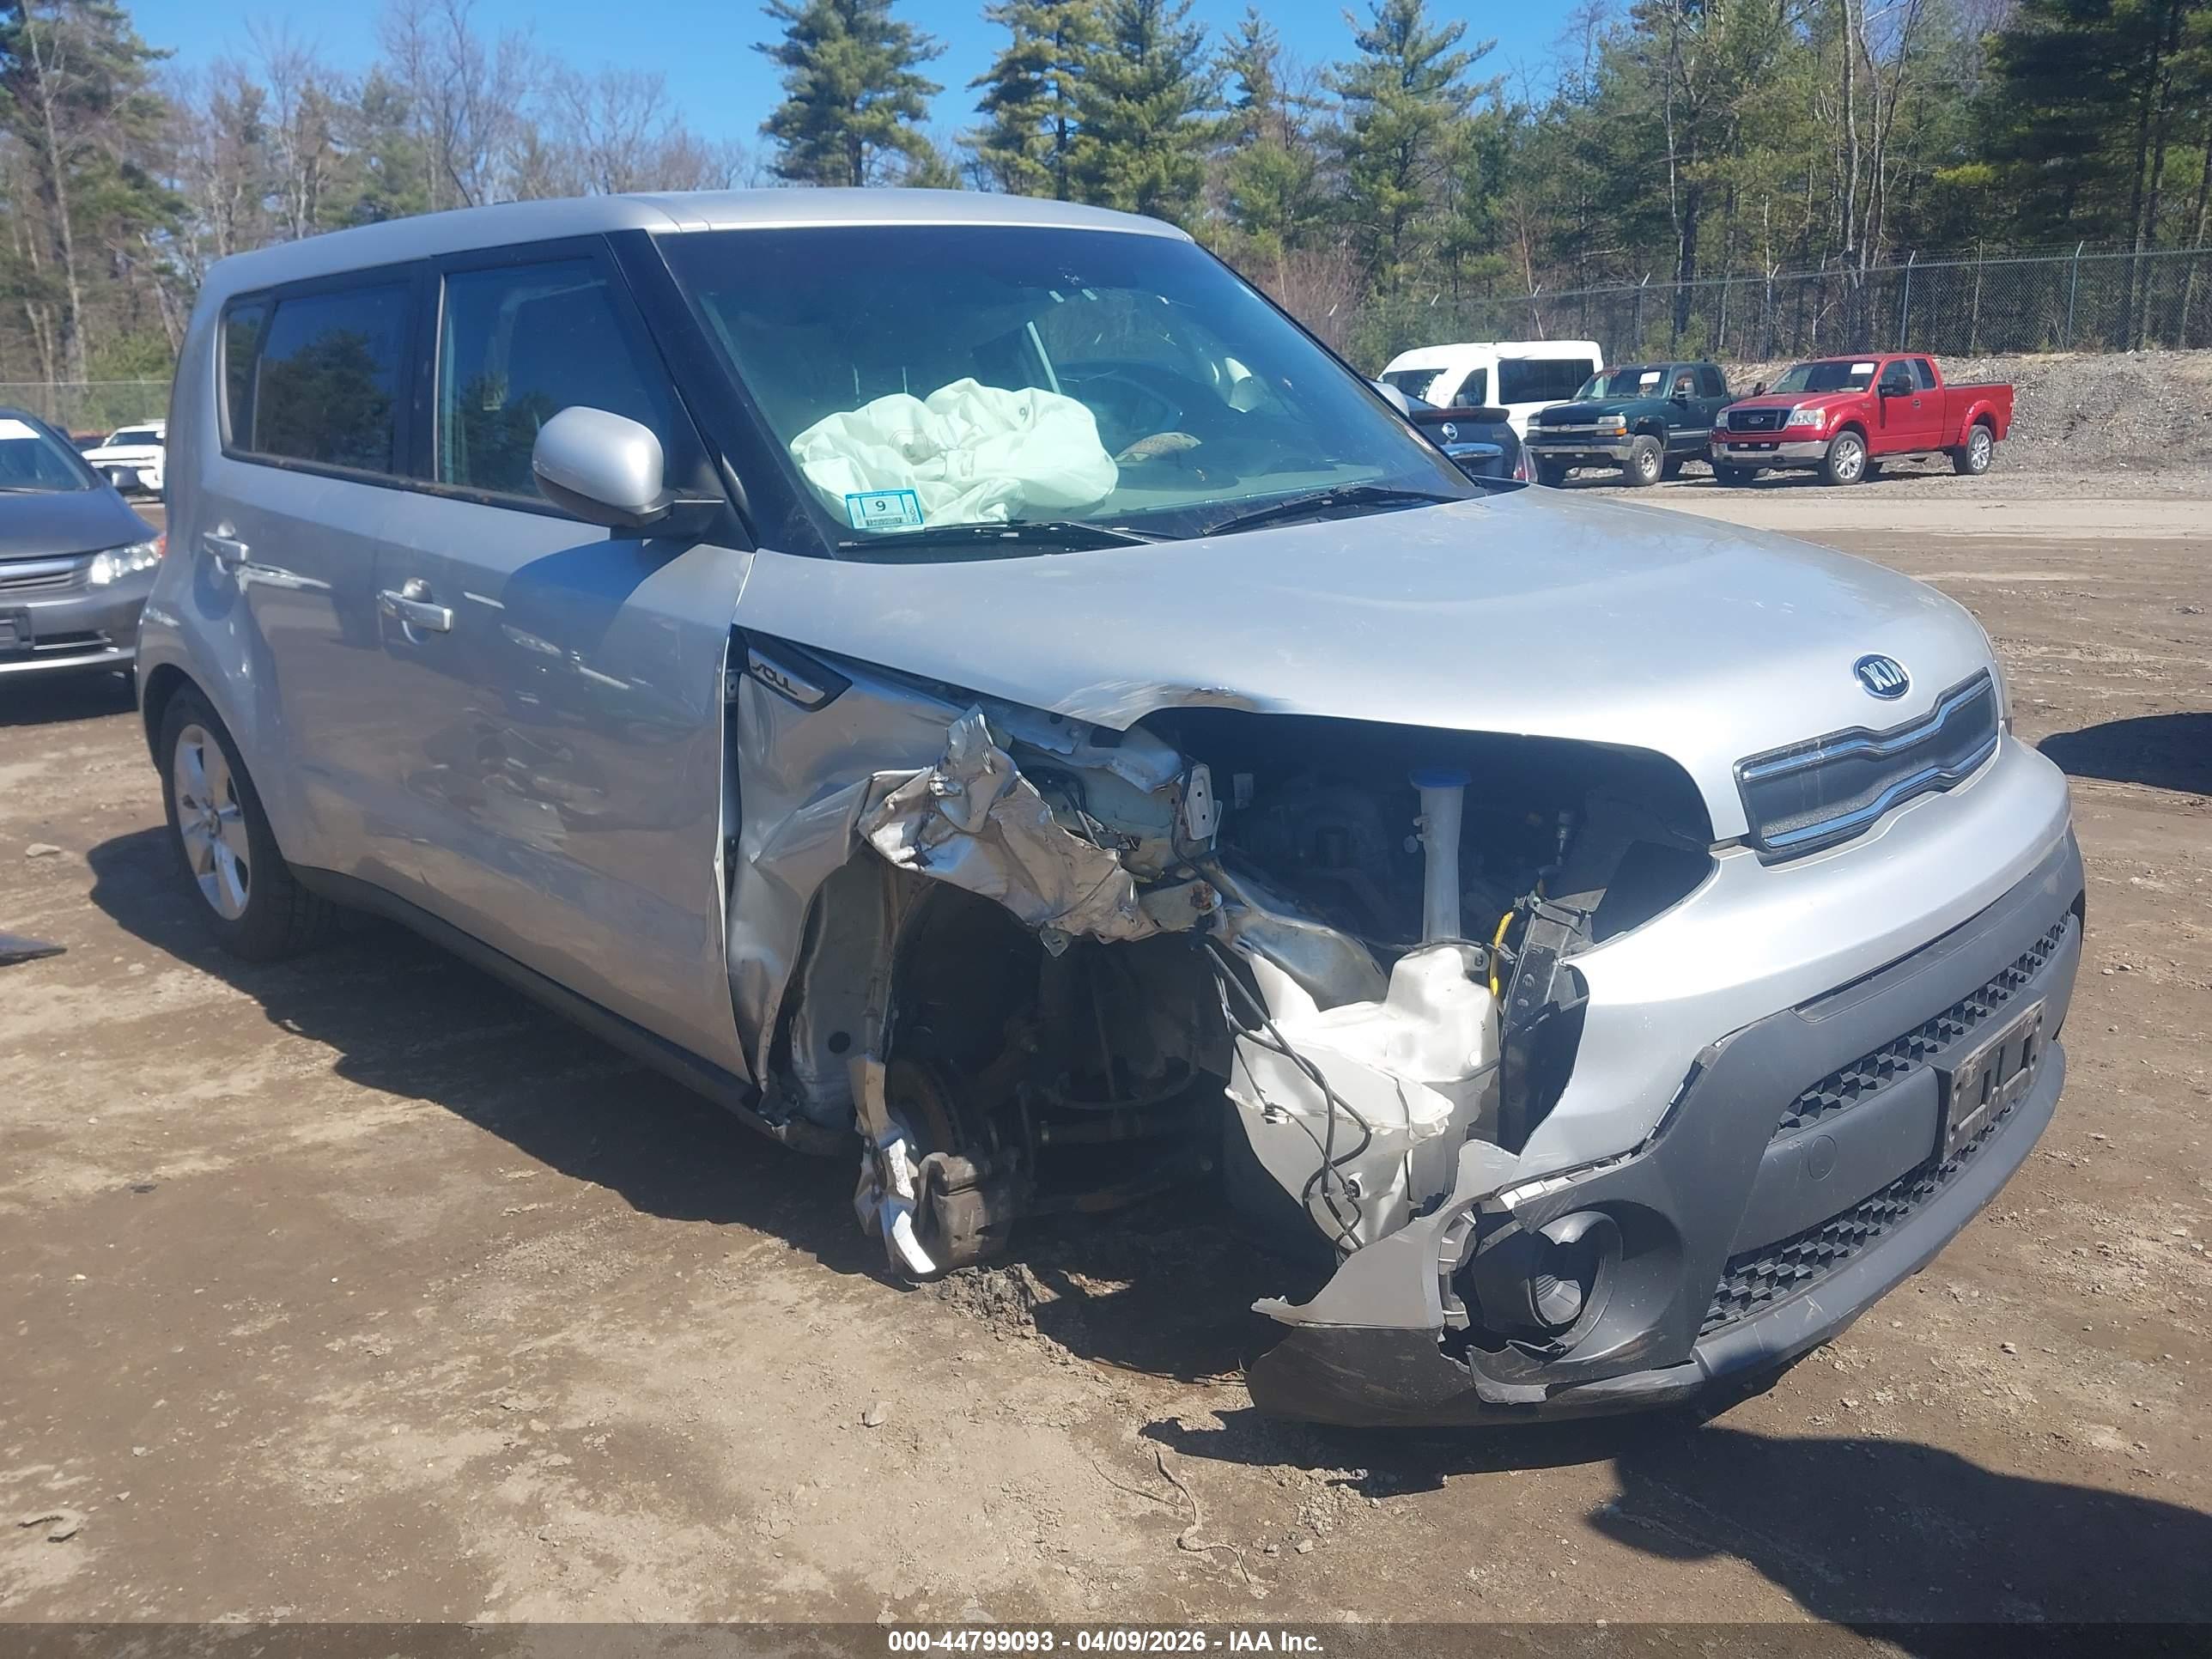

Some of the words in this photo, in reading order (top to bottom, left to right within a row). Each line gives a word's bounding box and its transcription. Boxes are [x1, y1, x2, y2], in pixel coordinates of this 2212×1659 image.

[874, 500, 887, 513] 9
[752, 663, 799, 697] SOUL
[1859, 659, 1909, 691] KIA
